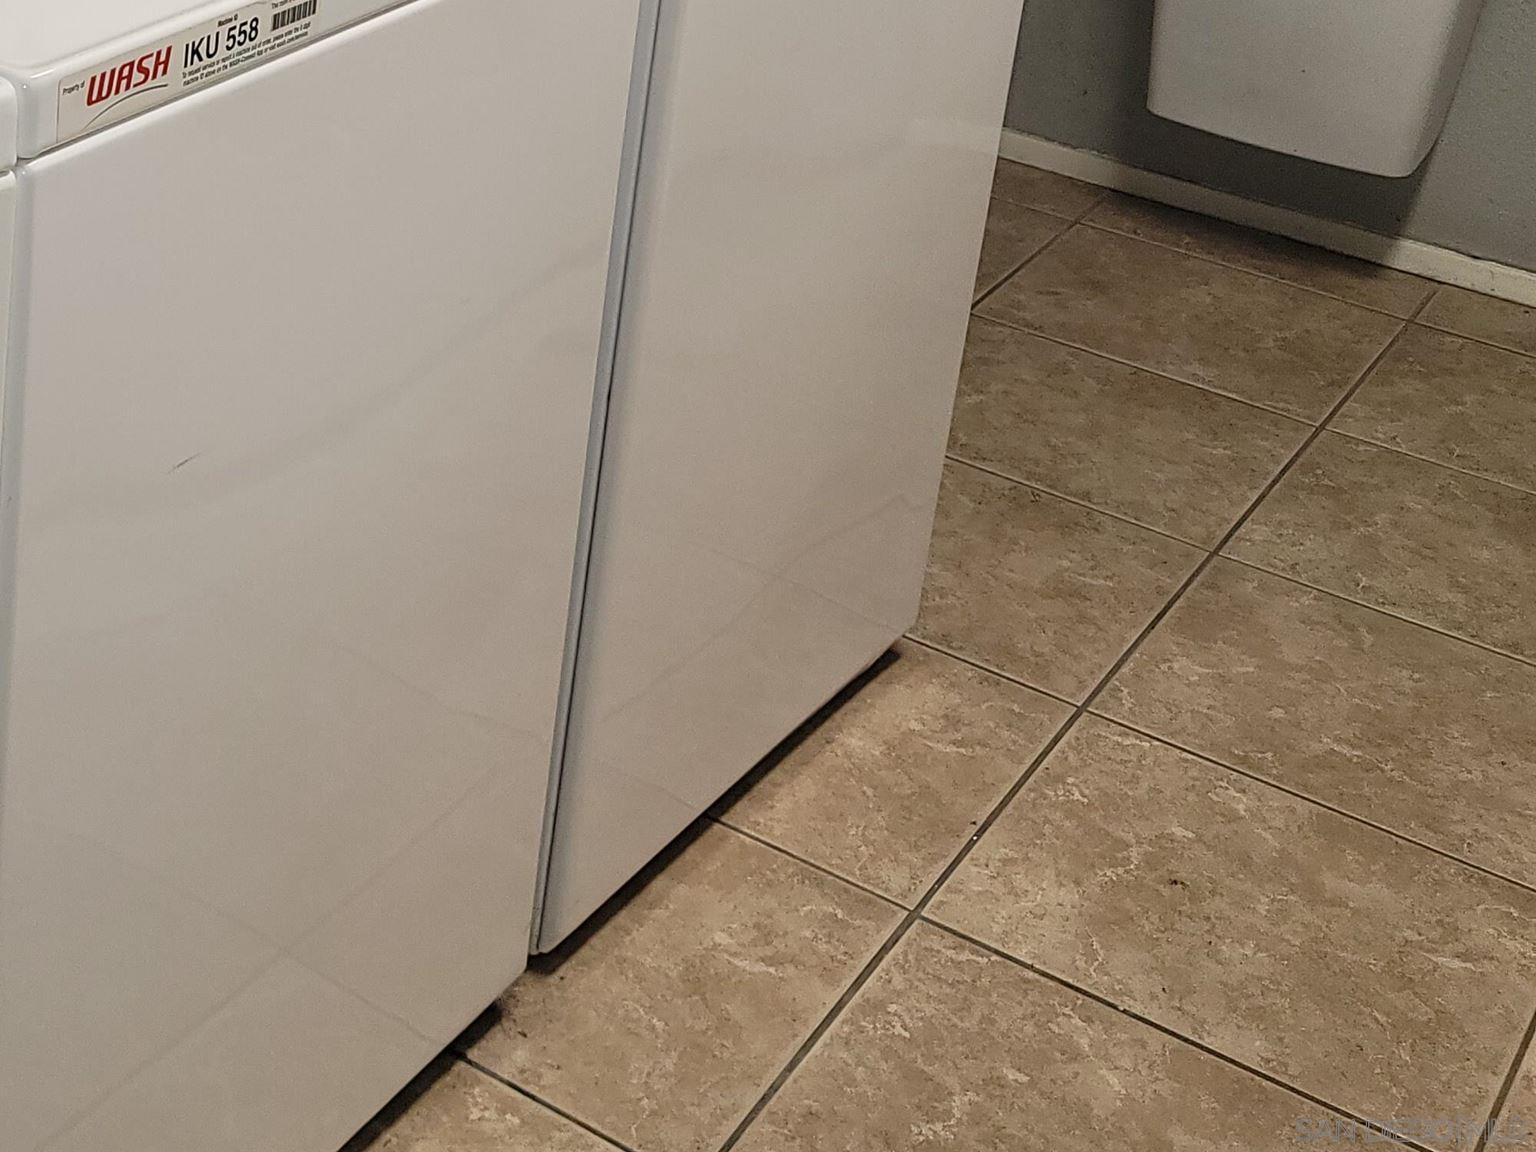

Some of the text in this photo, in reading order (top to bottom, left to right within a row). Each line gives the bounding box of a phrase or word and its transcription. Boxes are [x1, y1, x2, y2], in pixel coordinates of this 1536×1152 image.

[183, 31, 220, 69] IKU
[225, 16, 259, 51] 558
[86, 45, 173, 107] WASH
